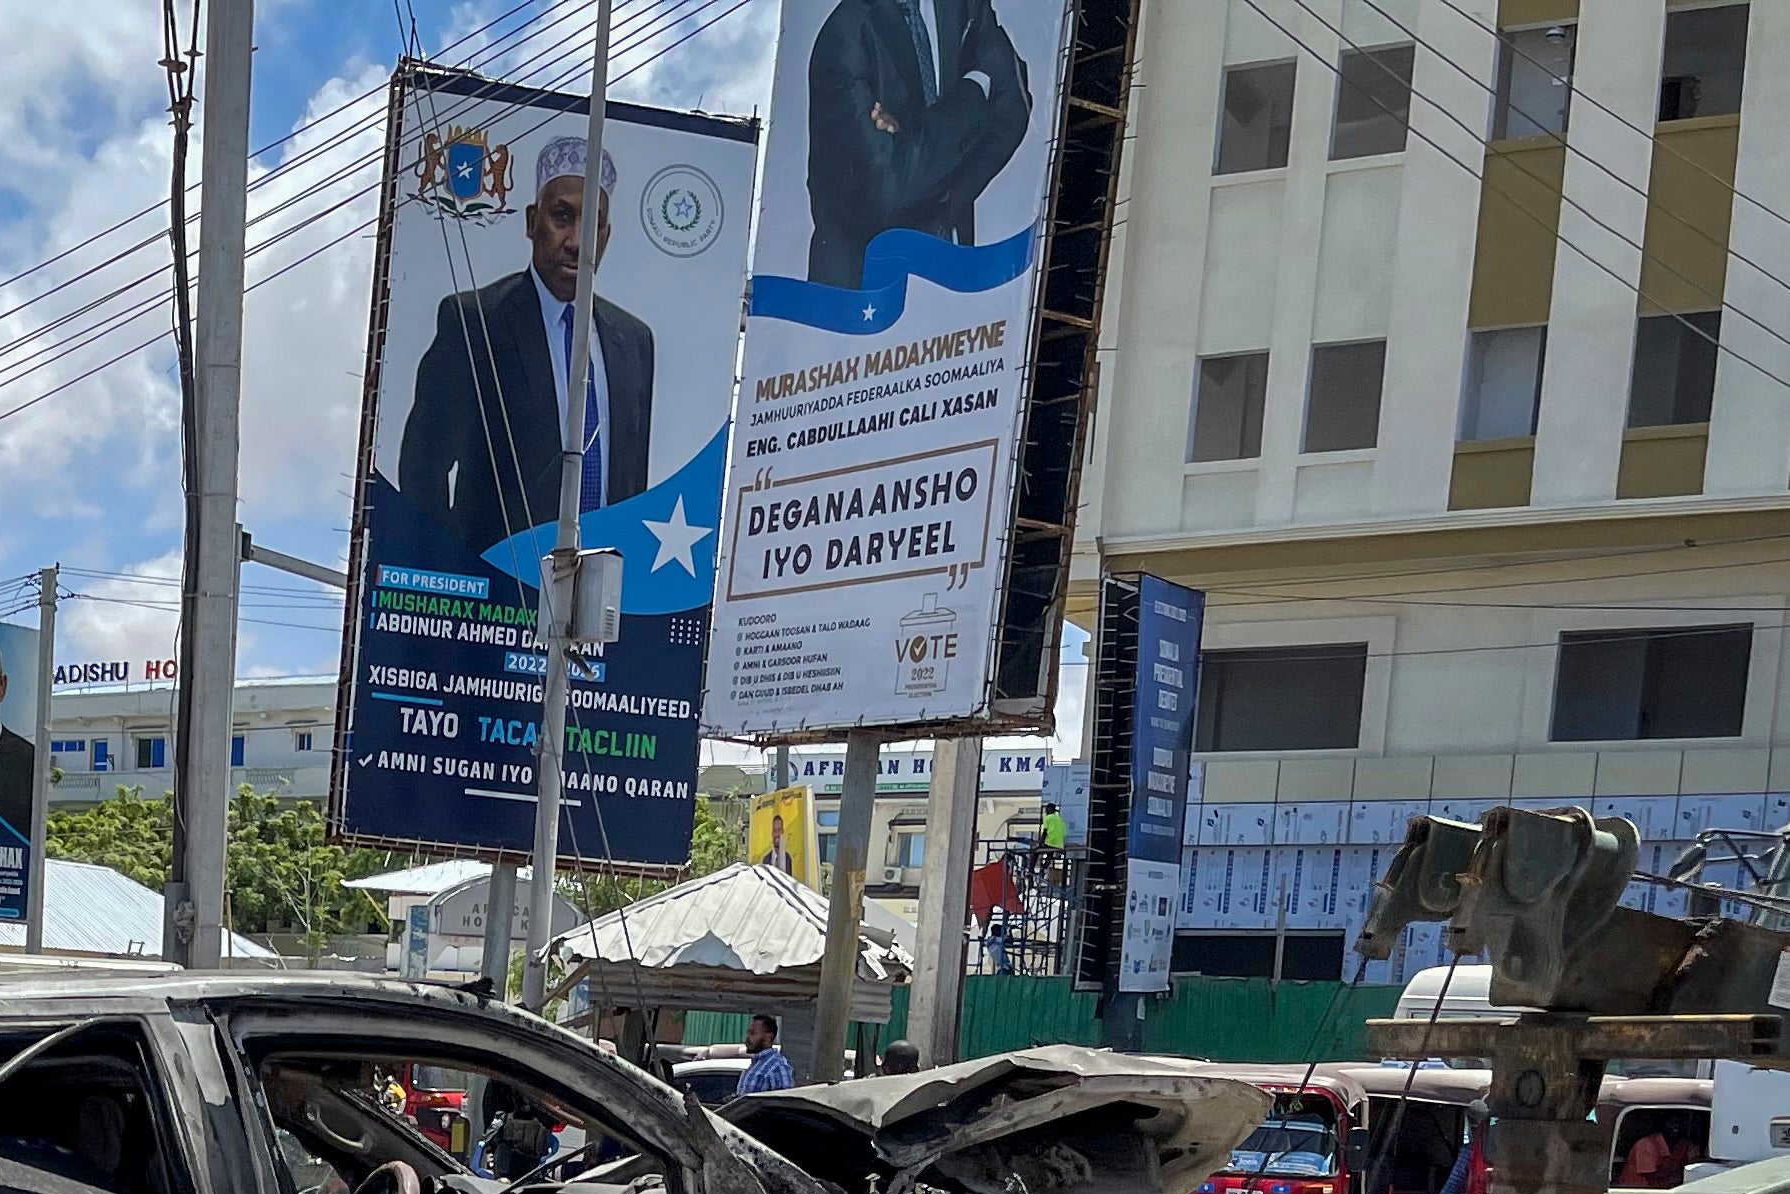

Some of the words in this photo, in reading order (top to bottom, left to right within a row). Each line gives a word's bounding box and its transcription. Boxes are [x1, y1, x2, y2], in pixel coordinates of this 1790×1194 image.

[755, 356, 860, 403] MURASHAX
[863, 320, 1006, 378] MADAXWEYNE
[750, 396, 843, 427] JAMHUURIYADDA
[847, 378, 922, 406] FEDERAALKA
[924, 358, 1004, 389] SOOMAALIYA
[746, 437, 781, 458] ENG.
[786, 411, 894, 450] CABDULLAAHI
[899, 401, 937, 426] CALI
[941, 388, 999, 418] XASAN
[748, 467, 978, 537] DEGANAANSHO
[762, 543, 812, 579] IYO
[826, 520, 955, 570] DARYEEL
[382, 570, 408, 585] FOR
[412, 574, 485, 594] PRESIDENT
[378, 590, 474, 619] MUSHARAX
[479, 603, 538, 627] MADAX
[376, 612, 453, 639] ABDINUR
[457, 622, 517, 647] AHMED
[895, 633, 958, 663] VOTE
[53, 661, 129, 684] ADISHU
[508, 655, 547, 672] 2022
[911, 667, 935, 681] 2022
[368, 665, 438, 691] XISBIGA
[443, 675, 543, 703] JAMHUURIG
[400, 707, 459, 738] TAYO
[478, 716, 540, 747] TACA
[565, 726, 657, 760] TACLIIN
[377, 750, 426, 773] AMNI
[432, 757, 495, 781] SUGAN
[501, 764, 533, 785] IYO
[625, 777, 688, 799] QARAN
[999, 756, 1046, 773] KM4
